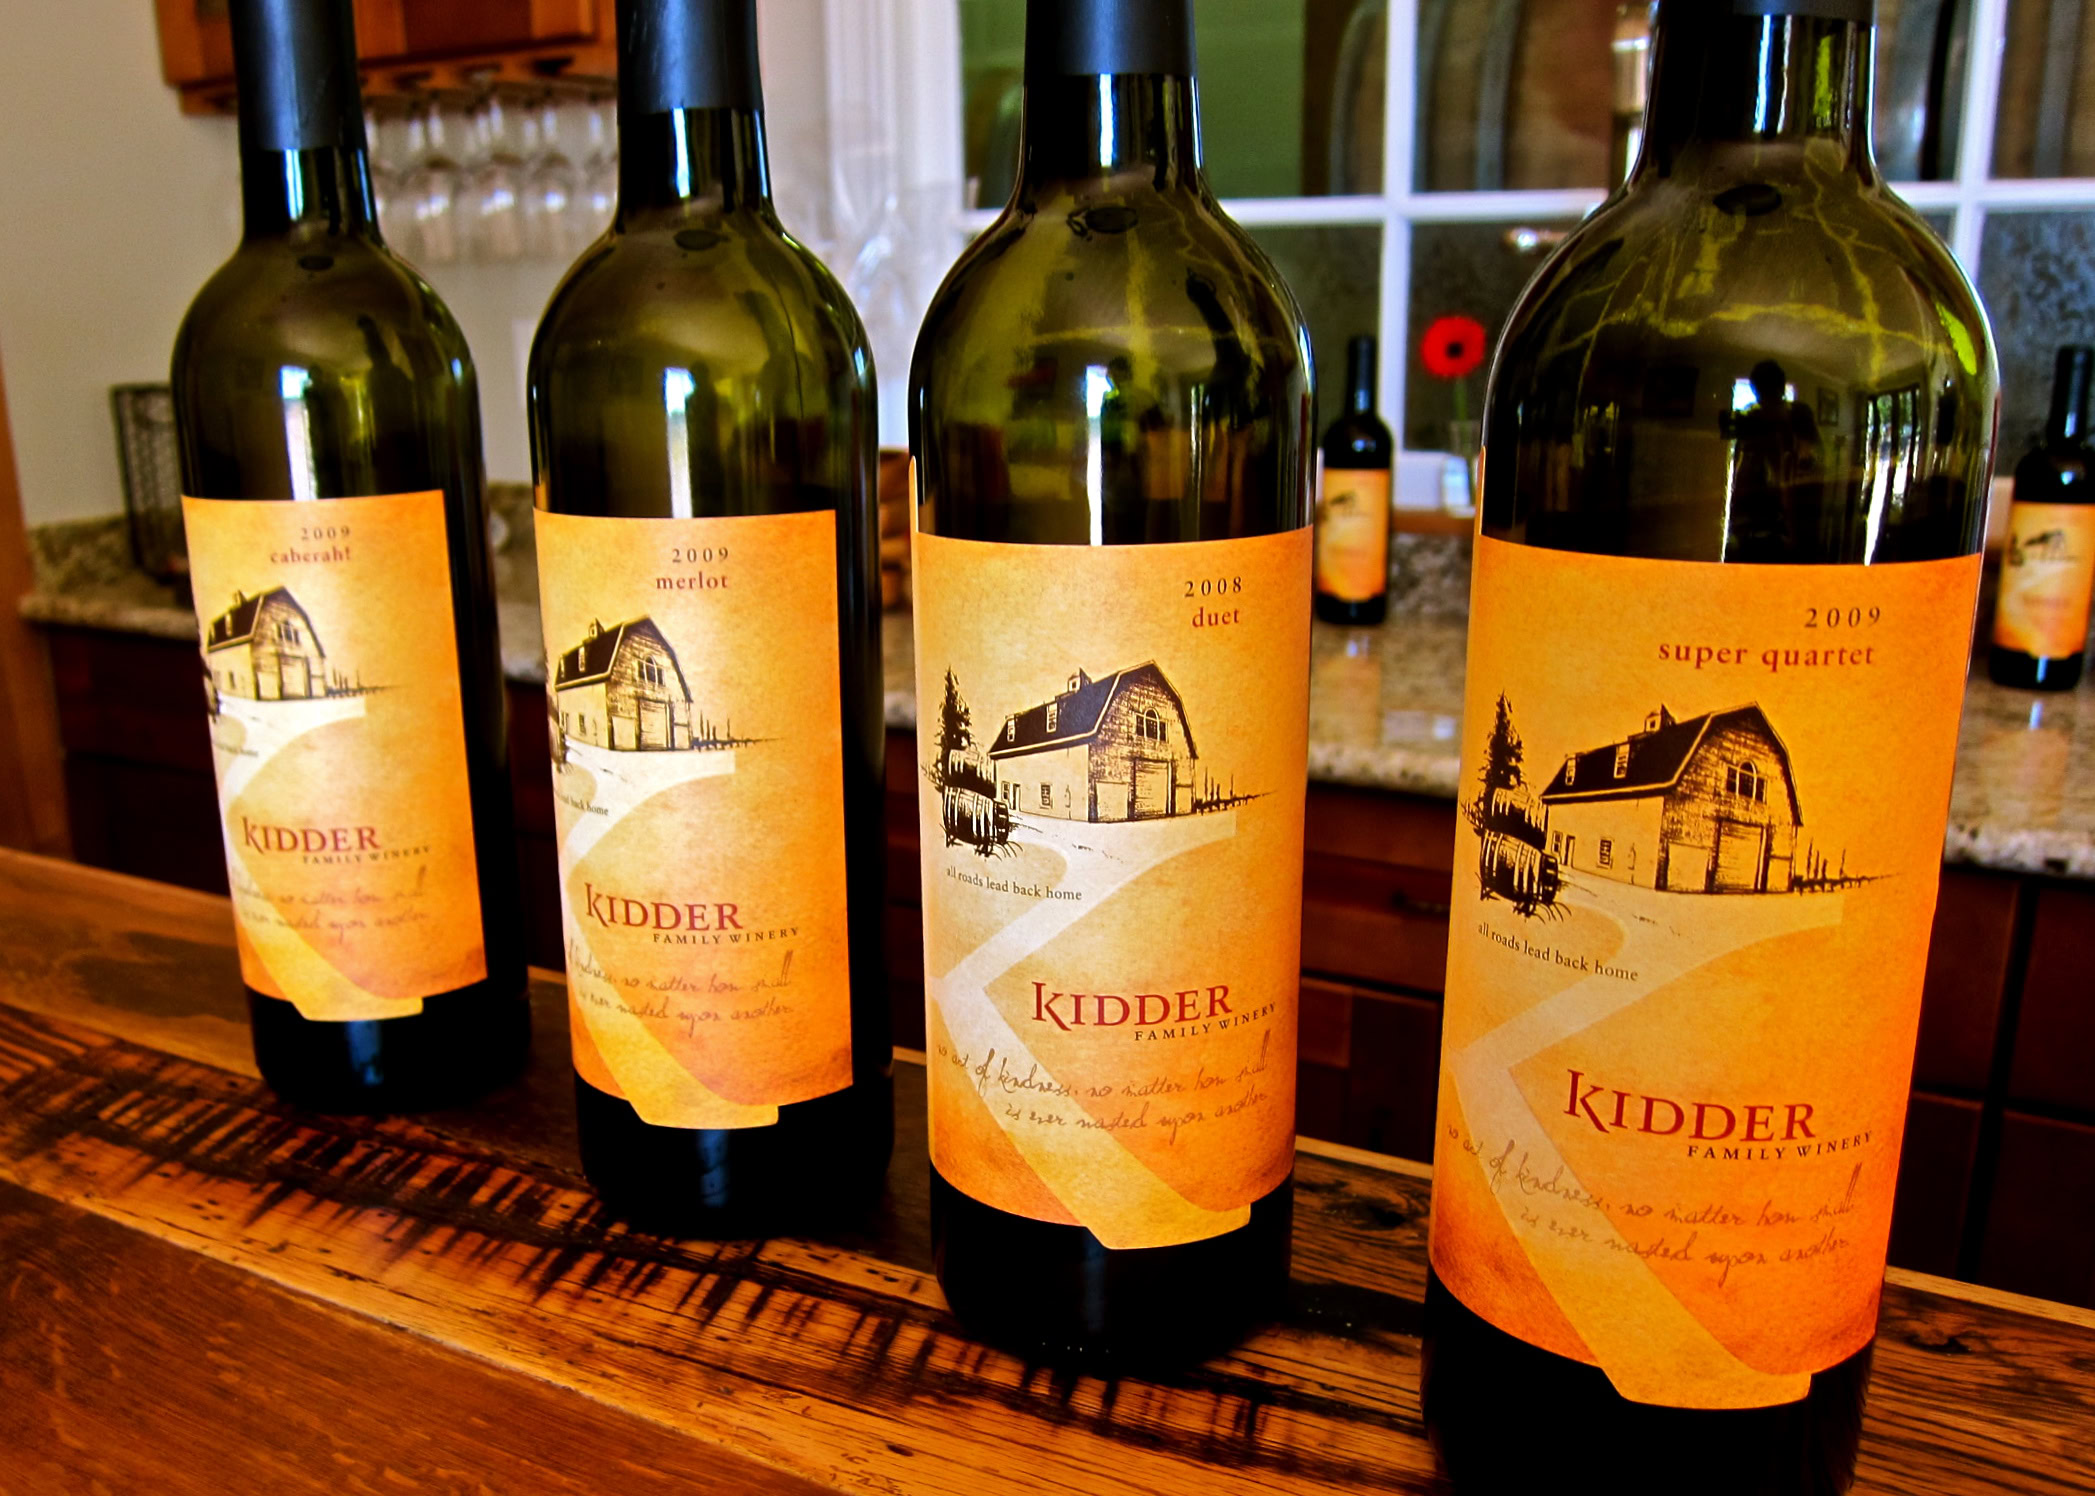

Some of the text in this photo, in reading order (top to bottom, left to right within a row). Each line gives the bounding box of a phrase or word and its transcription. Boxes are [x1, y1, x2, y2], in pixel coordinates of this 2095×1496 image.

[301, 526, 350, 541] 2009
[672, 547, 728, 563] 2009
[656, 571, 728, 589] merlot
[1184, 576, 1242, 598] 2008
[1191, 606, 1240, 628] duet
[1804, 607, 1881, 628] 2009
[1658, 643, 1875, 672] super quartet
[586, 801, 609, 816] home
[242, 816, 380, 855] KIDDER
[303, 846, 431, 865] FAMILY WINERY
[947, 866, 1082, 900] all roads lead back home
[584, 882, 743, 928] KIDDER
[653, 927, 799, 945] FAMILY WINERY
[1478, 922, 1639, 982] all roads lead back home
[1031, 981, 1233, 1032] KIDDER
[1134, 1002, 1277, 1042] FAMILY WINERY
[975, 1048, 995, 1097] of
[1086, 1084, 1112, 1098] no
[1120, 1075, 1187, 1098] matter
[1004, 1103, 1022, 1121] is
[1028, 1111, 1068, 1127] ever
[1213, 1084, 1268, 1118] another
[1563, 1068, 1818, 1142] KIDDER
[1686, 1130, 1874, 1161] FAMILY WINERY
[1489, 1139, 1516, 1195] of
[1618, 1204, 1654, 1217] no
[1664, 1203, 1746, 1225] matter
[1520, 1206, 1540, 1229] is
[1549, 1220, 1594, 1243] ever
[1779, 1226, 1851, 1263] another
